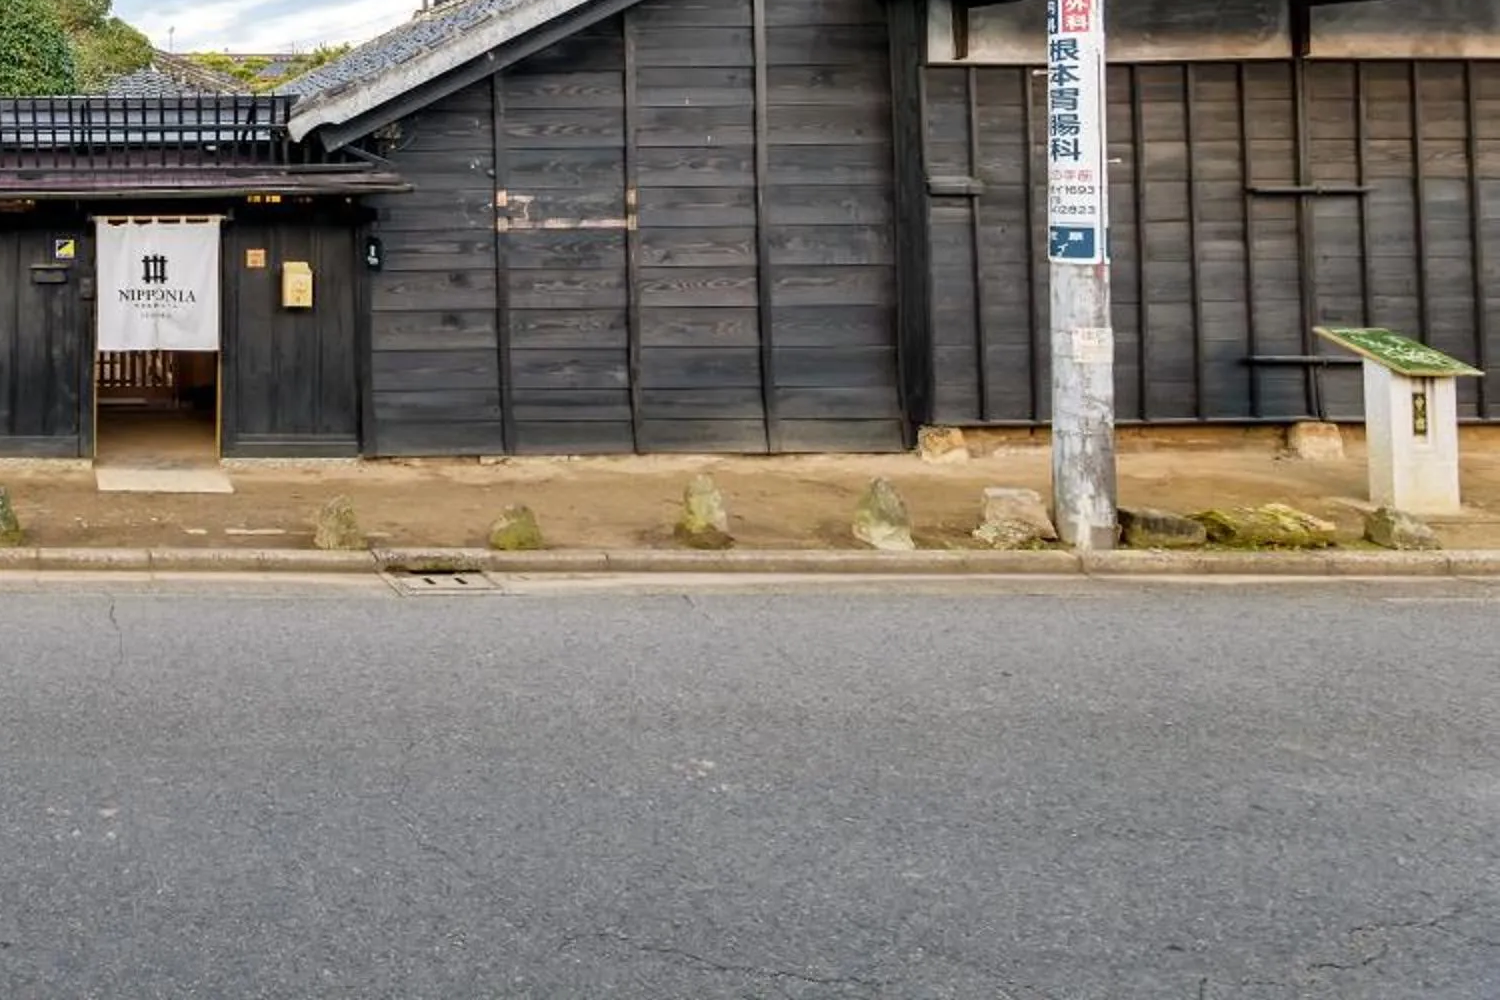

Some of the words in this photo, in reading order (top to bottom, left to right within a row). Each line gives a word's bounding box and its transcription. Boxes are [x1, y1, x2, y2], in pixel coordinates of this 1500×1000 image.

[1050, 38, 1081, 162] 根本胃腸科
[118, 289, 196, 303] NIPPONIA
